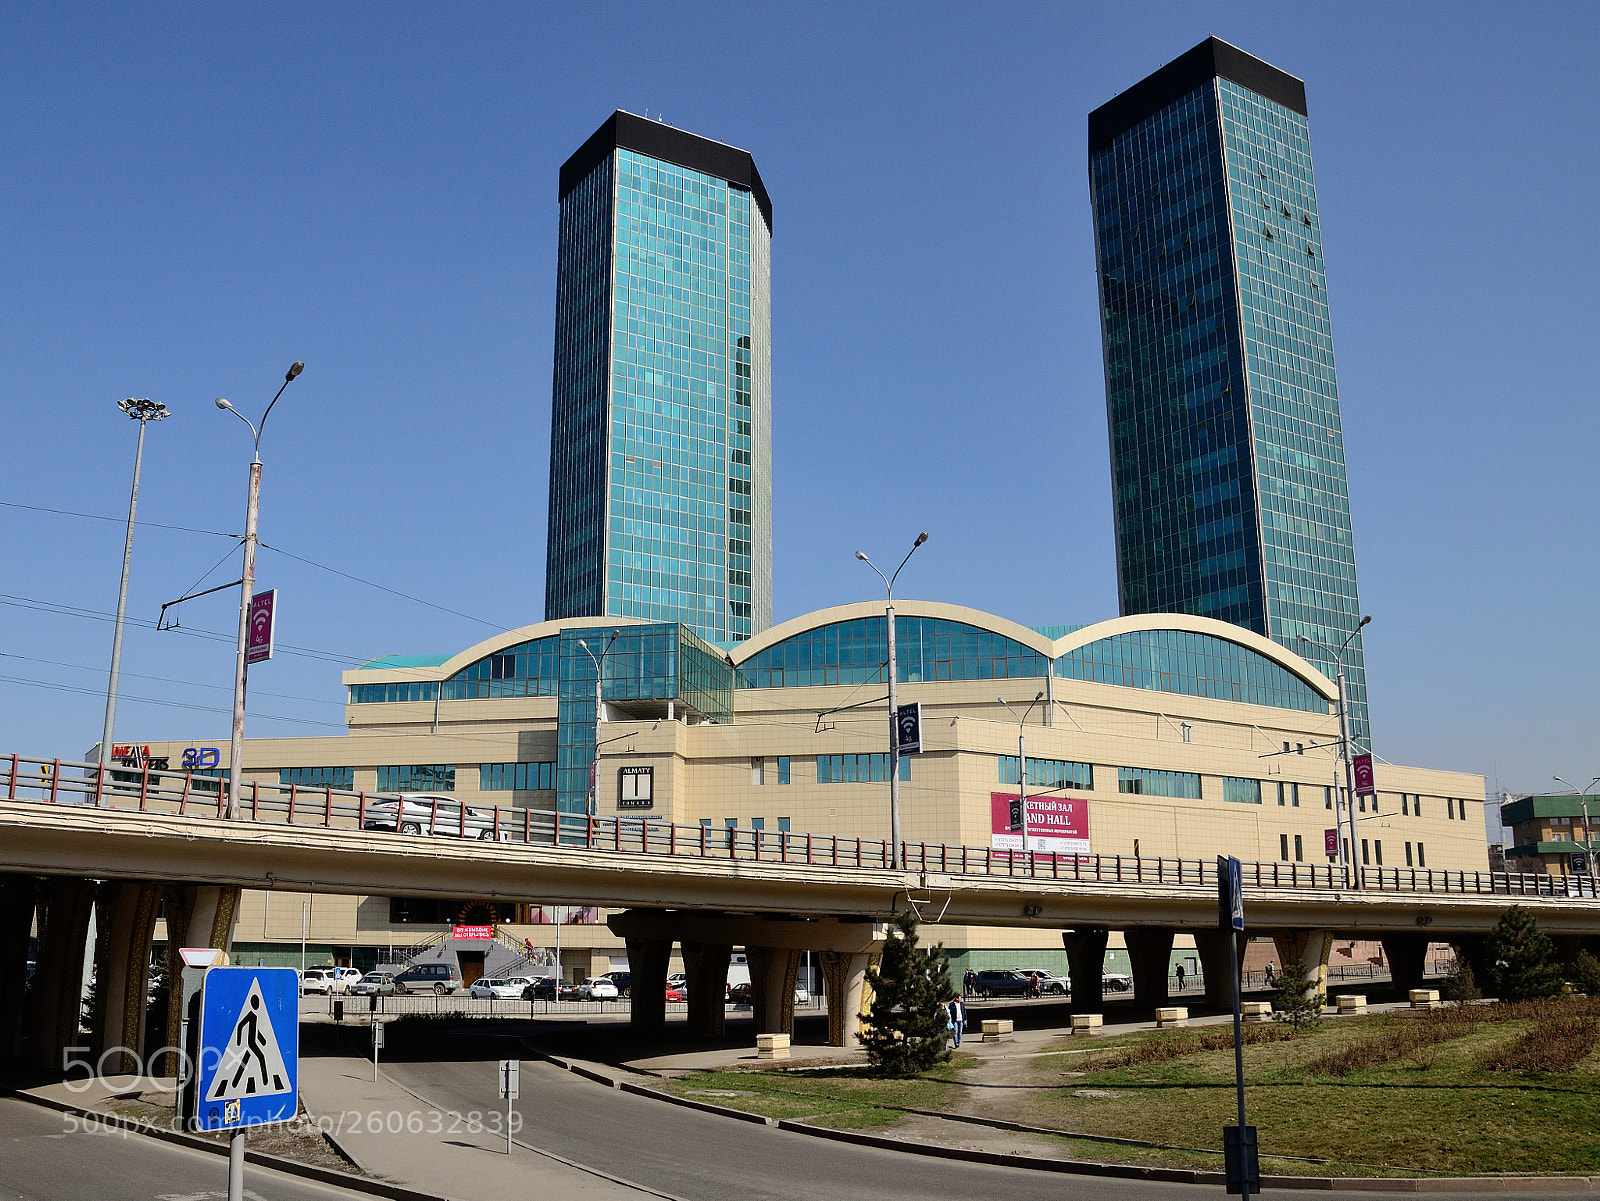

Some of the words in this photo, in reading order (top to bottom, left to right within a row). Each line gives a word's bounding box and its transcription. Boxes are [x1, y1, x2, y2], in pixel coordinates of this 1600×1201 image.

[253, 599, 272, 608] ALTEL
[900, 708, 917, 716] ALTEL
[111, 743, 151, 758] INEMA
[182, 747, 220, 767] 3D
[1058, 803, 1073, 813] ЗАЛ
[1026, 813, 1045, 824] AND
[1047, 814, 1071, 825] HALL
